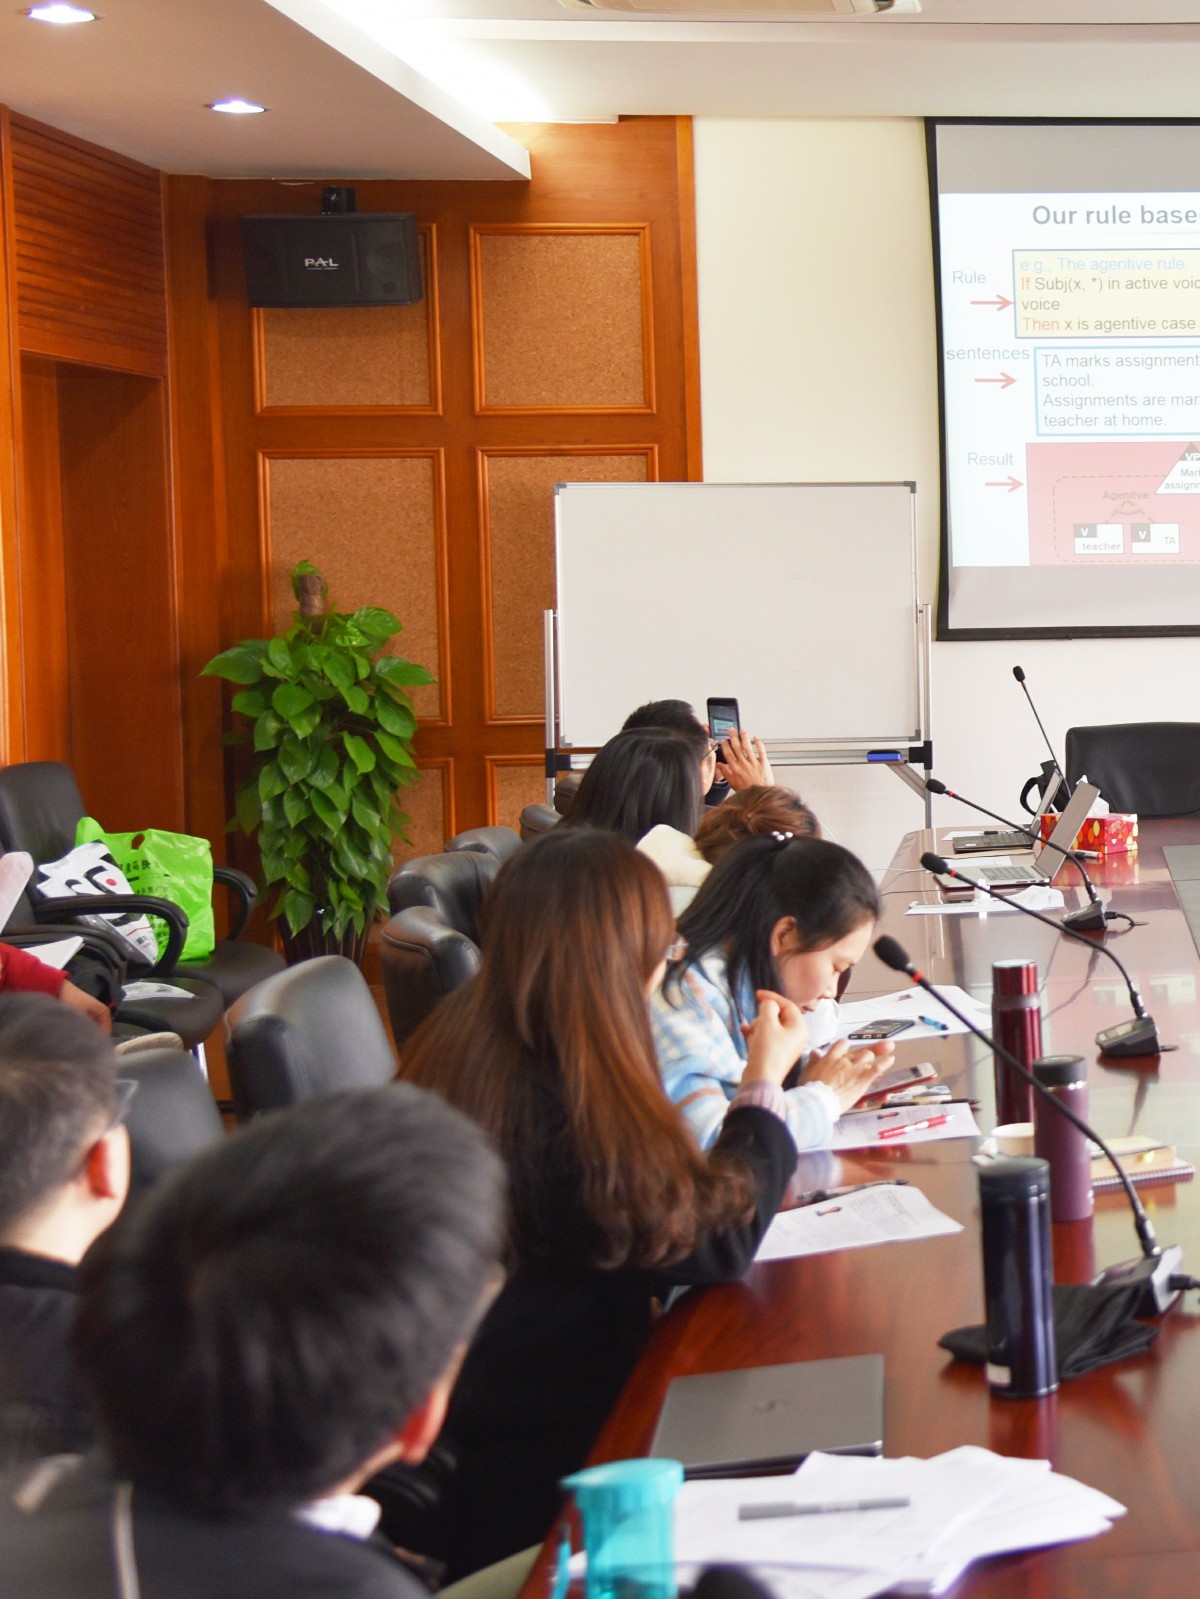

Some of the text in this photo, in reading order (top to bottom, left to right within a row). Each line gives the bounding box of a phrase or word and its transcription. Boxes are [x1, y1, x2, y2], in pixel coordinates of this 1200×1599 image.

[1032, 205, 1077, 225] Our
[1086, 205, 1132, 225] rule
[304, 257, 339, 267] PAL
[1057, 257, 1086, 271] The
[1089, 257, 1153, 274] agentive
[1157, 257, 1190, 271] rule:
[952, 271, 987, 285] Rule
[1021, 276, 1031, 290] If
[1108, 276, 1120, 290] in
[1125, 276, 1168, 290] active
[1021, 297, 1061, 311] voice
[1022, 316, 1197, 333] Then x is agentive case
[946, 347, 1031, 360] sentences
[1042, 354, 1061, 368] TA
[1066, 353, 1111, 368] marks
[1042, 373, 1095, 387] school.
[1043, 393, 1138, 410] Assignments
[1142, 394, 1167, 406] are
[1044, 413, 1168, 427] teacher at home.
[967, 452, 1015, 466] Result
[1184, 452, 1200, 461] VP
[1102, 490, 1150, 501] Agentive
[1082, 542, 1121, 551] teacher
[1163, 536, 1177, 545] TA
